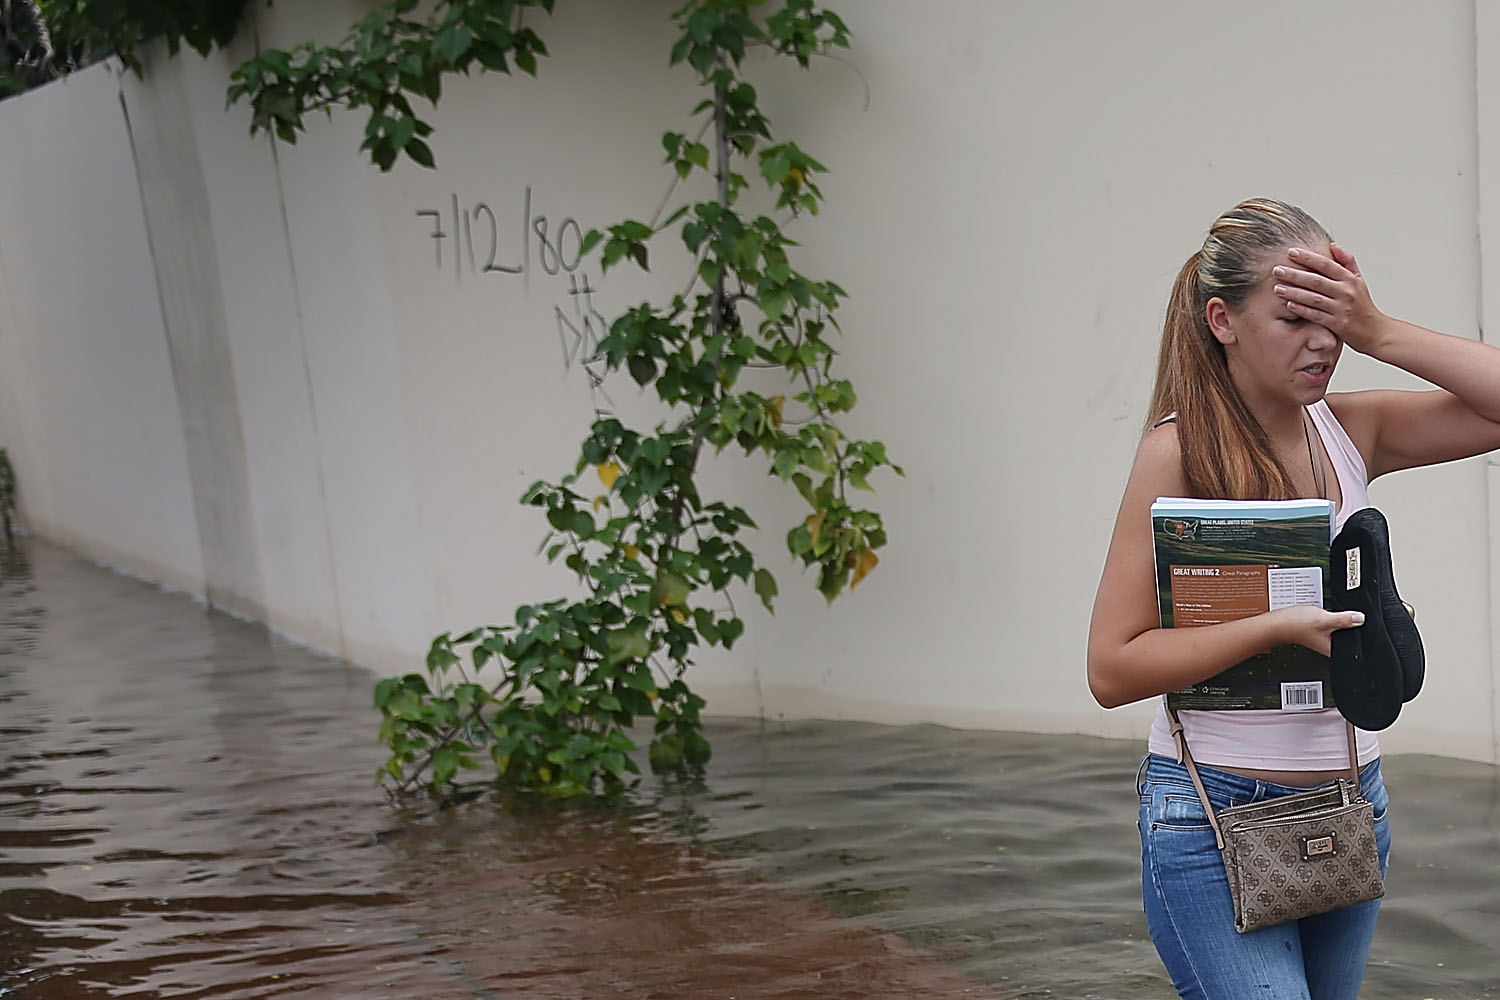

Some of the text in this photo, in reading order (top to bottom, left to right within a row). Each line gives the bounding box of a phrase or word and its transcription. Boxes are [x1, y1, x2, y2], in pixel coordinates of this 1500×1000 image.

[1173, 568, 1190, 576] GREAT
[1191, 568, 1214, 576] WRITING
[1214, 568, 1220, 576] 2
